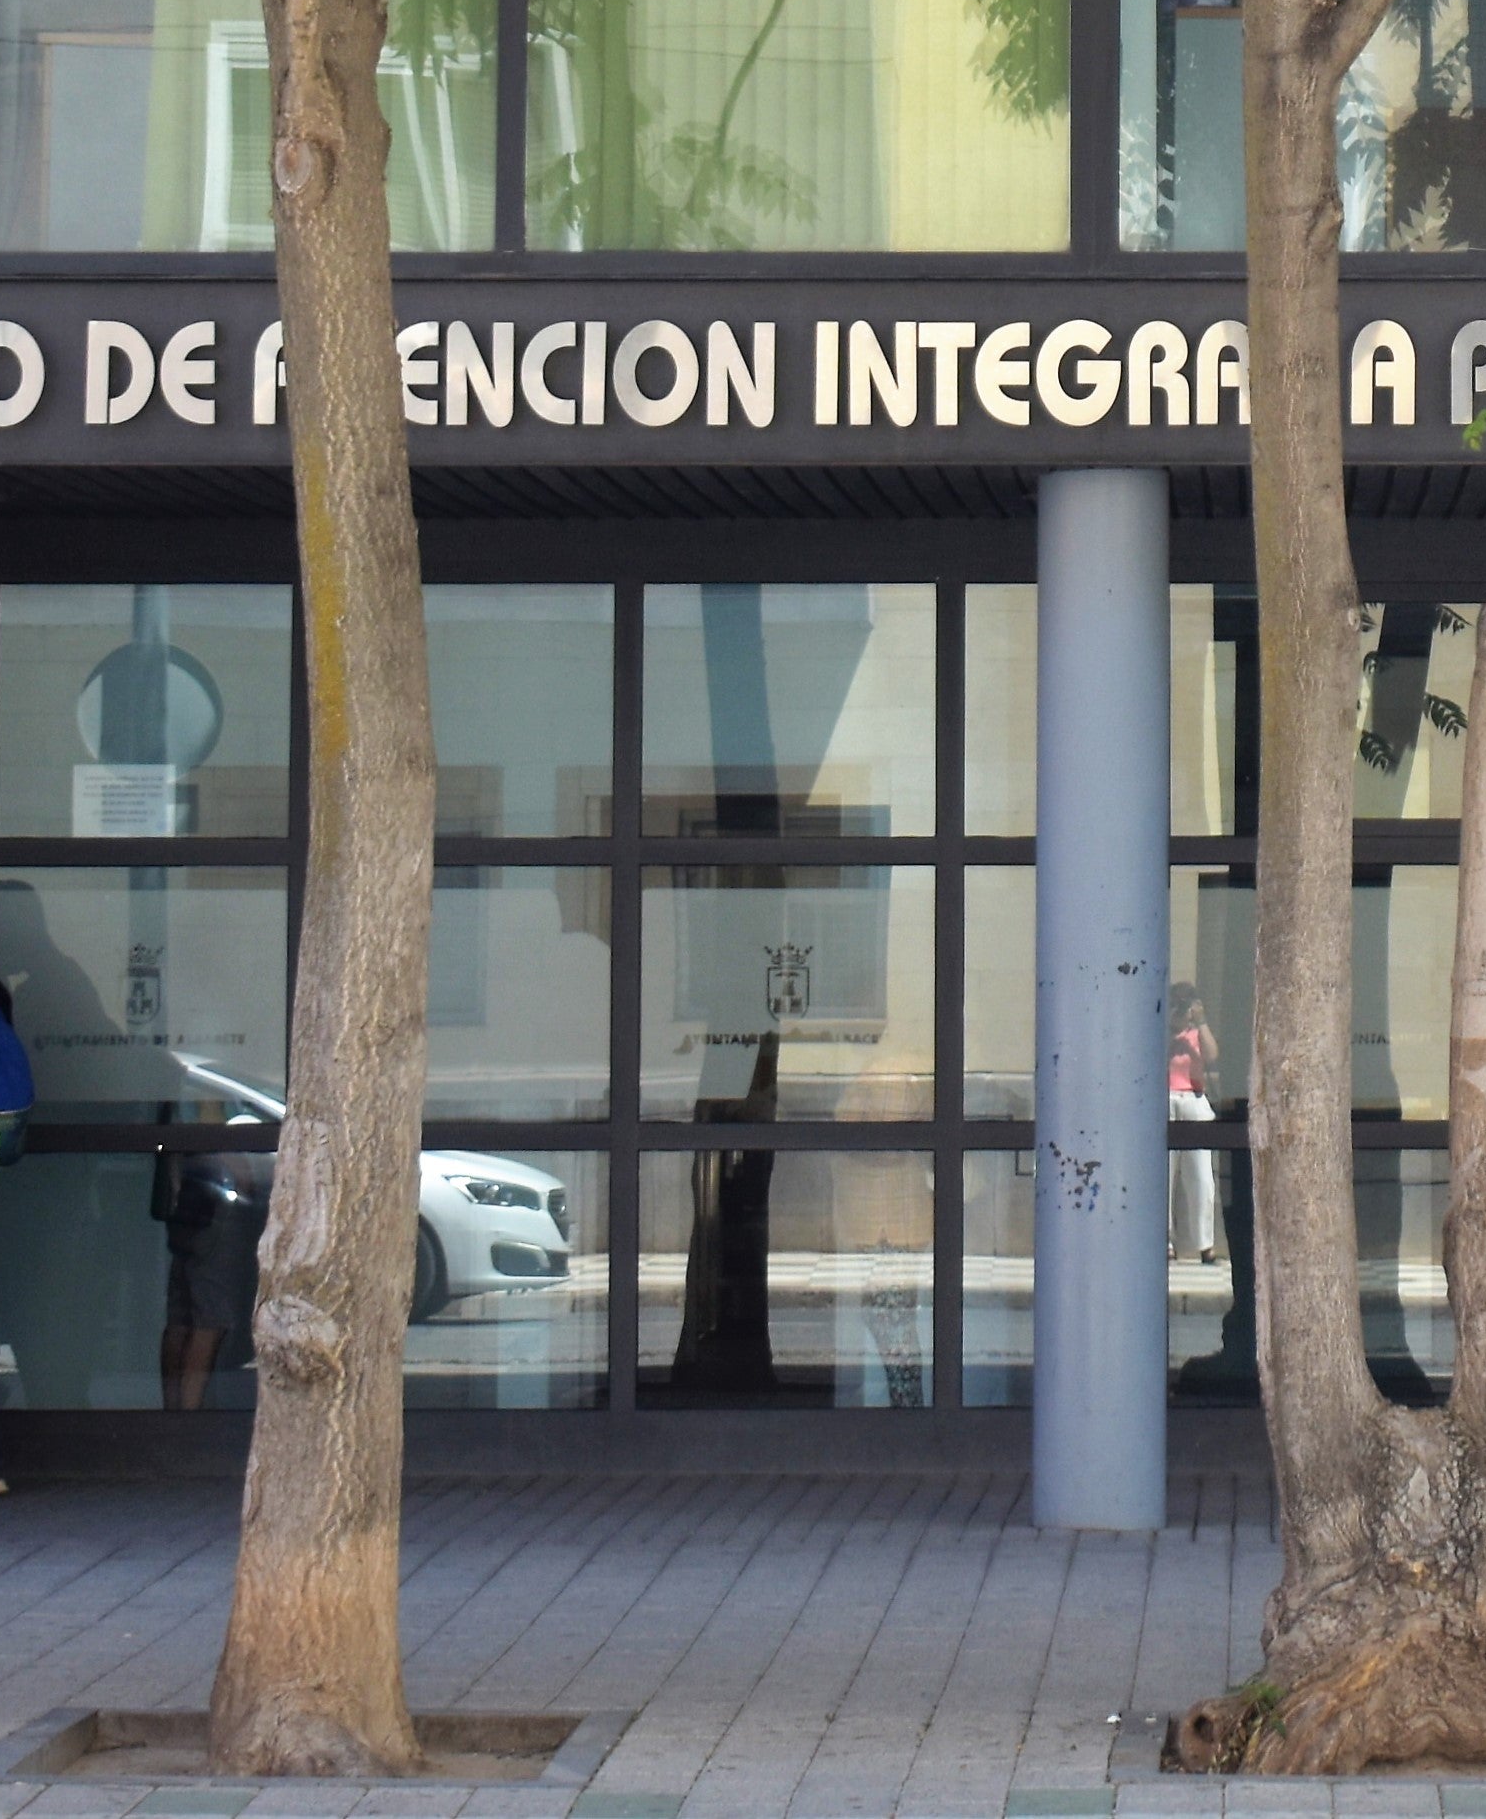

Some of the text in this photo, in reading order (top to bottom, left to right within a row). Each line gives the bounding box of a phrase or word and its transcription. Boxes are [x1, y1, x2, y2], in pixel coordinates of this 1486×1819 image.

[84, 320, 216, 425] DE
[252, 319, 776, 428] ENCION
[813, 319, 1252, 427] INTEGRA
[1349, 319, 1416, 425] A
